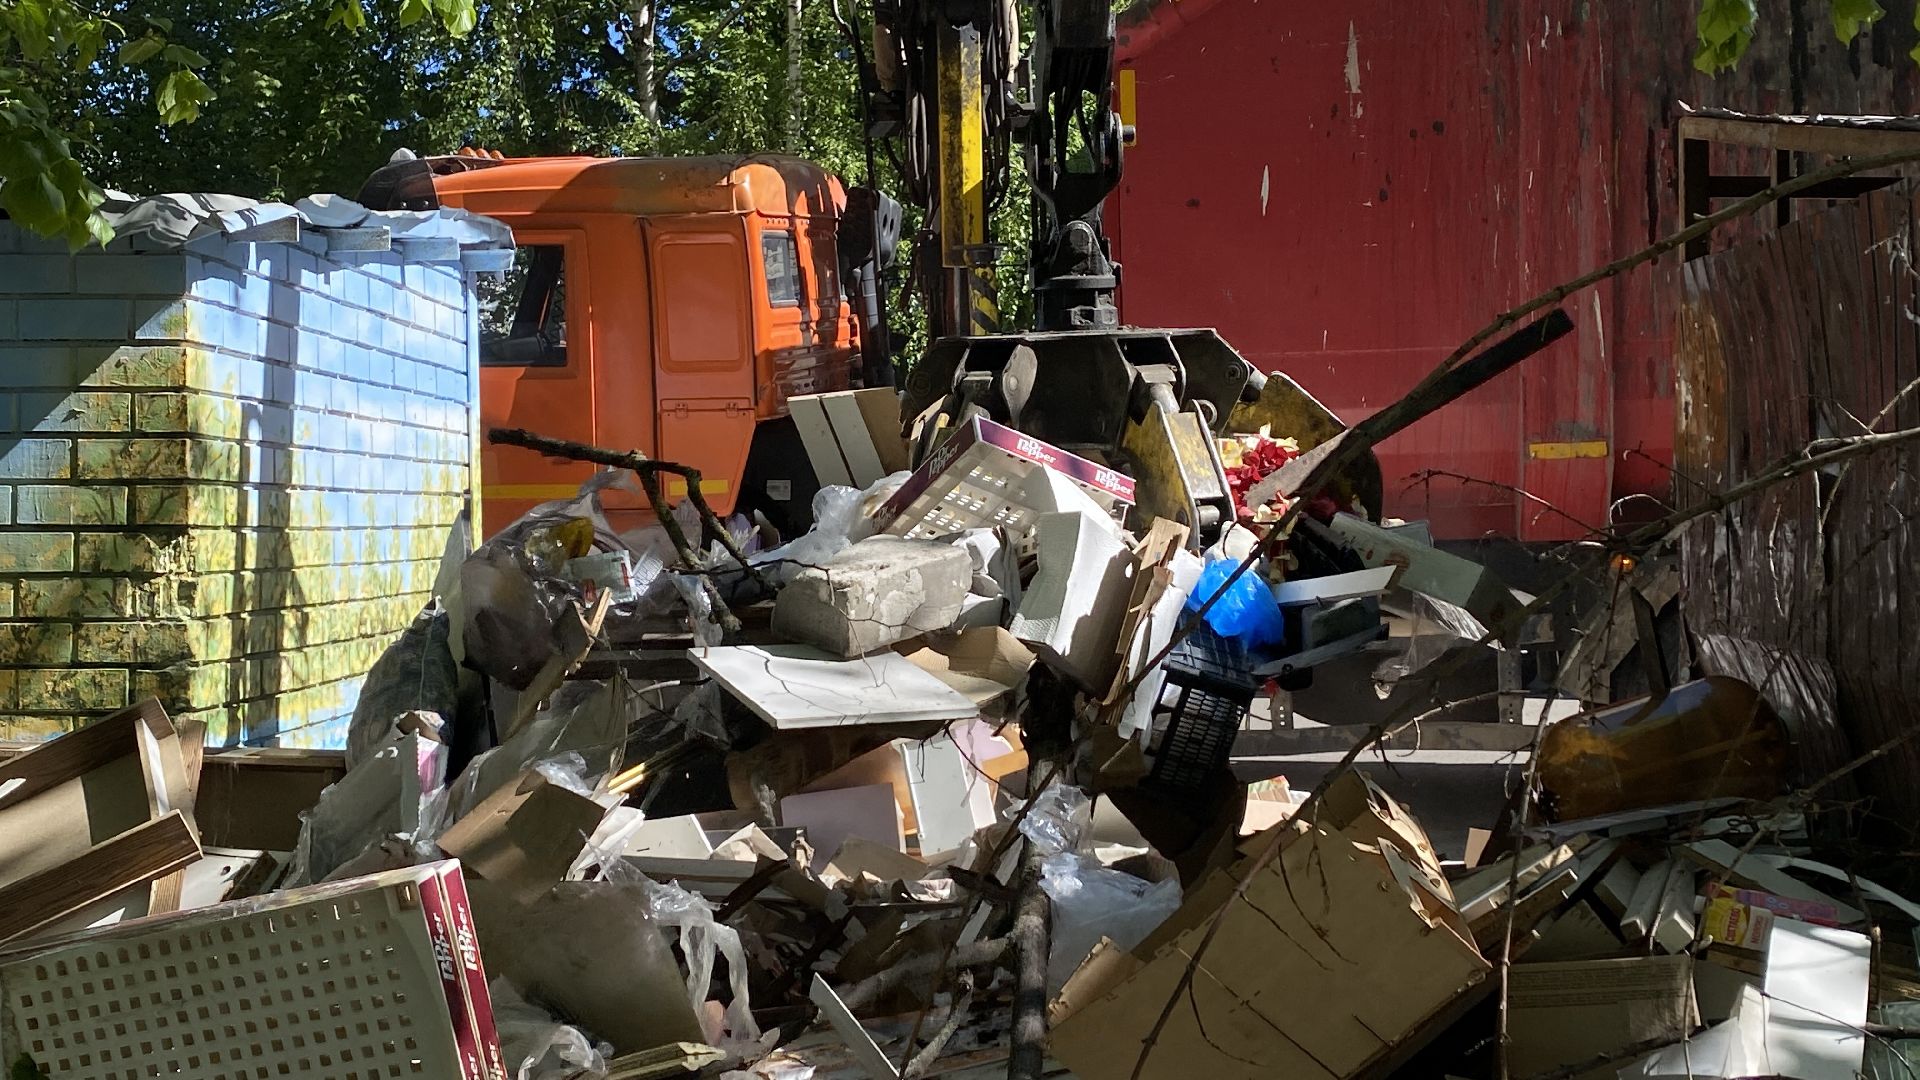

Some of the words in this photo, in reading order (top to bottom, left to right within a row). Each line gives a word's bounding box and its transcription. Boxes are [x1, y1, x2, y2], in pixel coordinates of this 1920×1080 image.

[1016, 437, 1057, 464] Pepper
[1029, 439, 1044, 452] Dr
[1105, 470, 1121, 484] Dr
[433, 912, 455, 981] Pepper
[457, 903, 478, 970] Pepper
[457, 926, 469, 951] Dr
